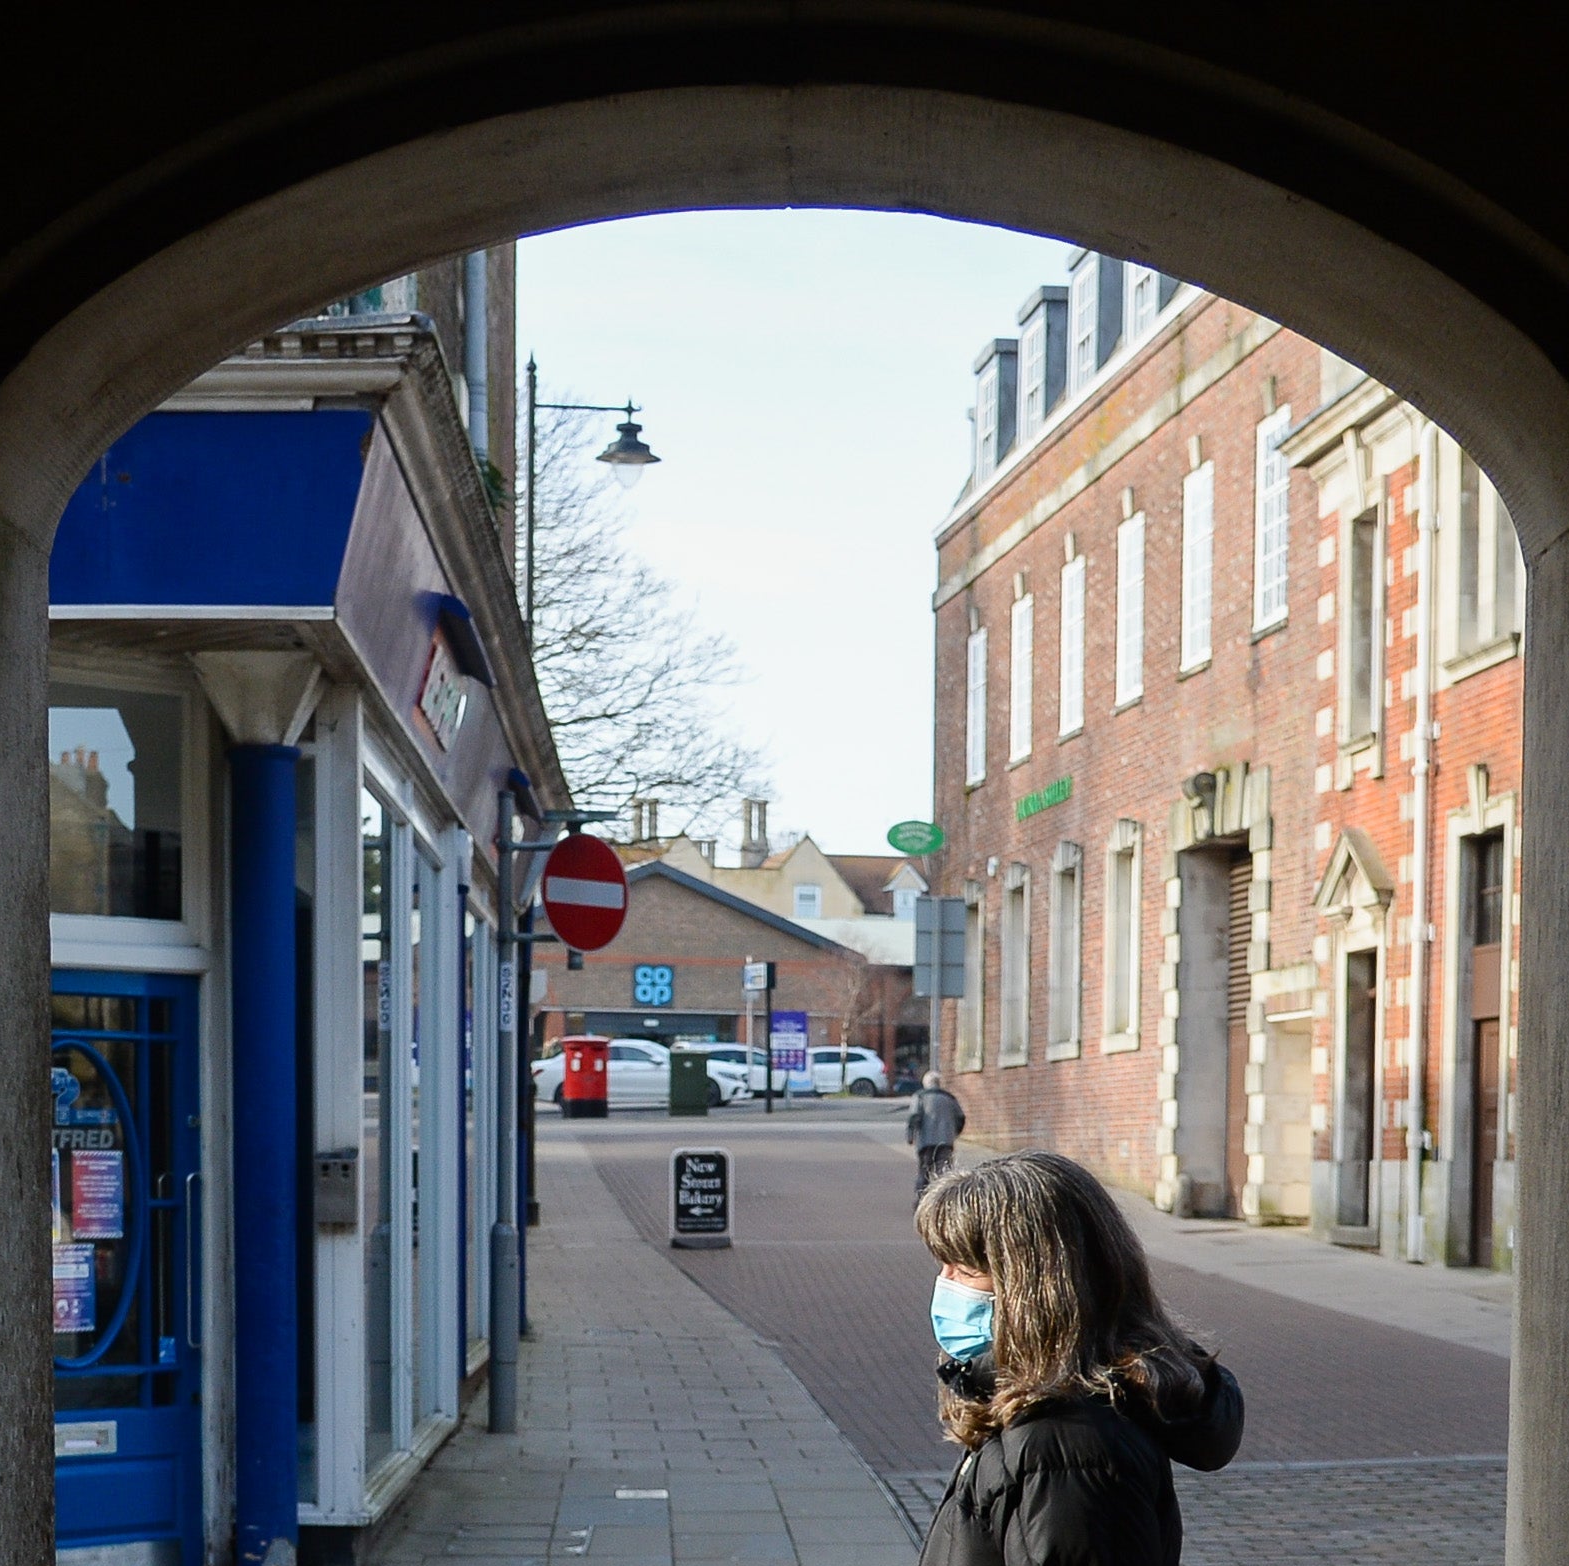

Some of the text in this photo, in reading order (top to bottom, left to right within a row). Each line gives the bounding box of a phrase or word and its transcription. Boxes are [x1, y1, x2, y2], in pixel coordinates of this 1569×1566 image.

[51, 1129, 114, 1150] TFRED
[685, 1157, 717, 1173] New
[679, 1190, 723, 1208] Bakery
